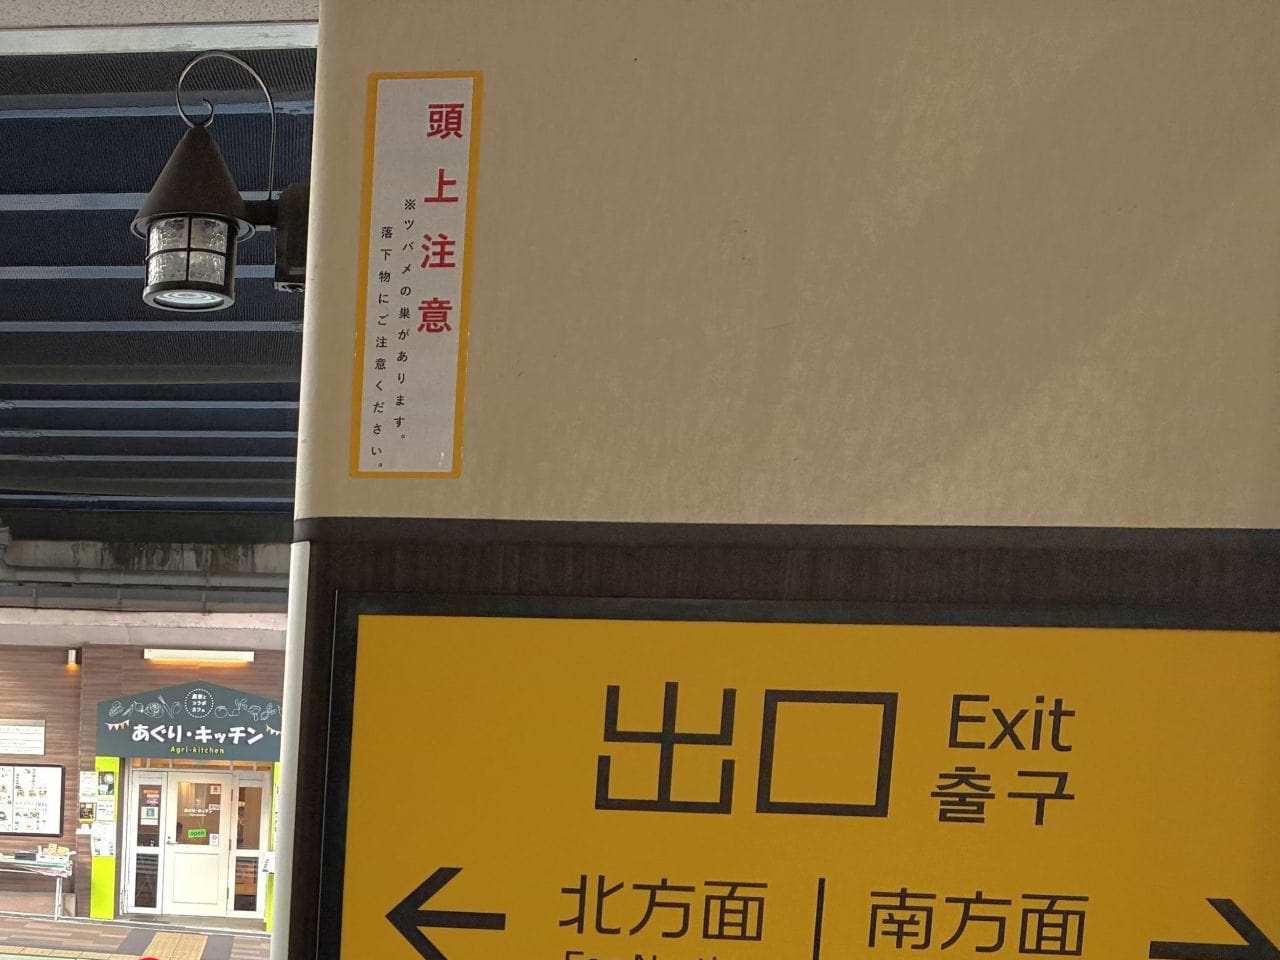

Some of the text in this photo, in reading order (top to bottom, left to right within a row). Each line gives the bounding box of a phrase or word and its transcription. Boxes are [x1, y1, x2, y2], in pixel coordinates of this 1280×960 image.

[417, 103, 464, 333] 頭上注意
[371, 226, 393, 468] 落下物にご注意ください。
[132, 724, 263, 744] あぐり・キッチン
[170, 746, 225, 754] Agri-kitchen
[595, 682, 898, 817] 出口
[949, 694, 1075, 752] Exit
[931, 767, 1075, 826] 출구
[559, 874, 767, 941] 北方面
[869, 888, 1089, 957] 南方面
